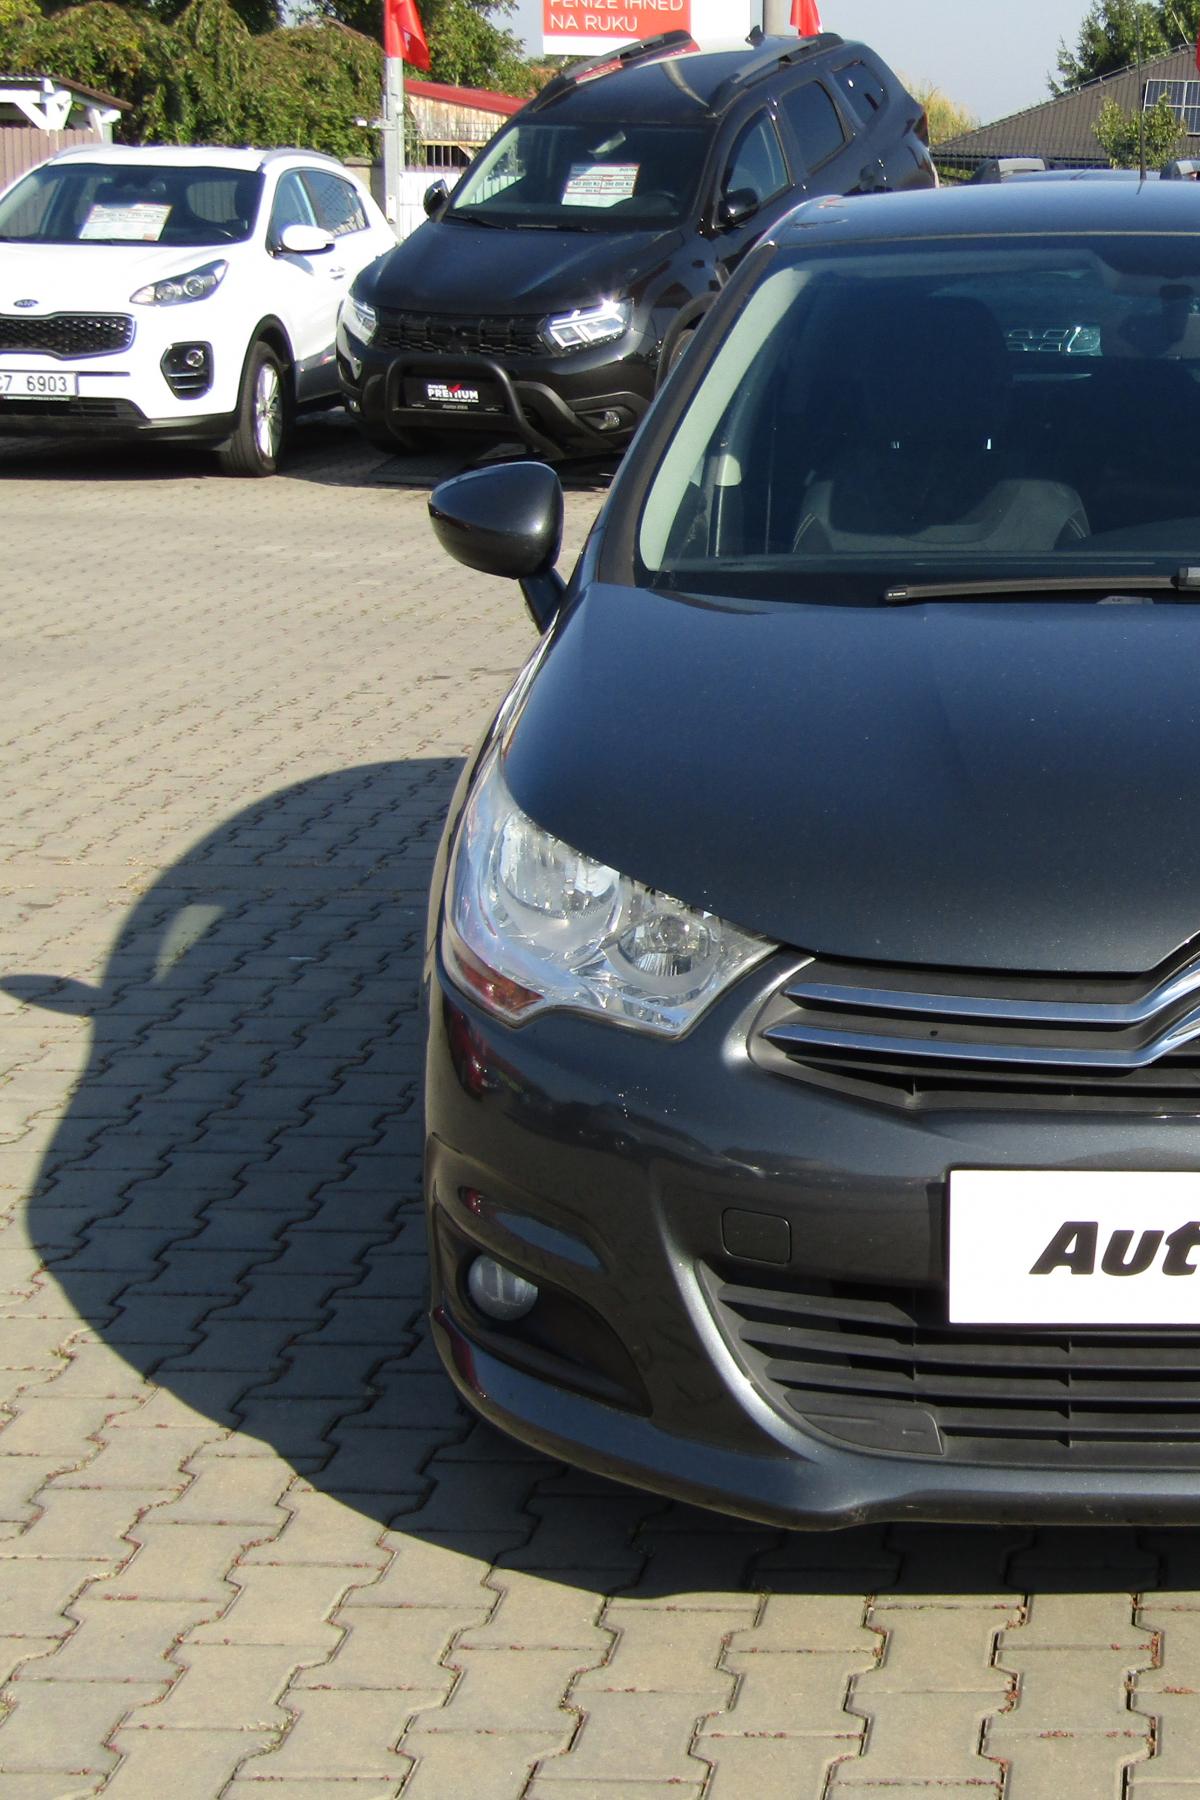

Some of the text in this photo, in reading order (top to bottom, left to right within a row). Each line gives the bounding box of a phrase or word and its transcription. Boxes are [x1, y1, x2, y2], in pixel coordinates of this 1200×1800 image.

[625, 0, 684, 11] IHNED
[550, 14, 638, 32] NA RUKU
[26, 375, 68, 392] 6903
